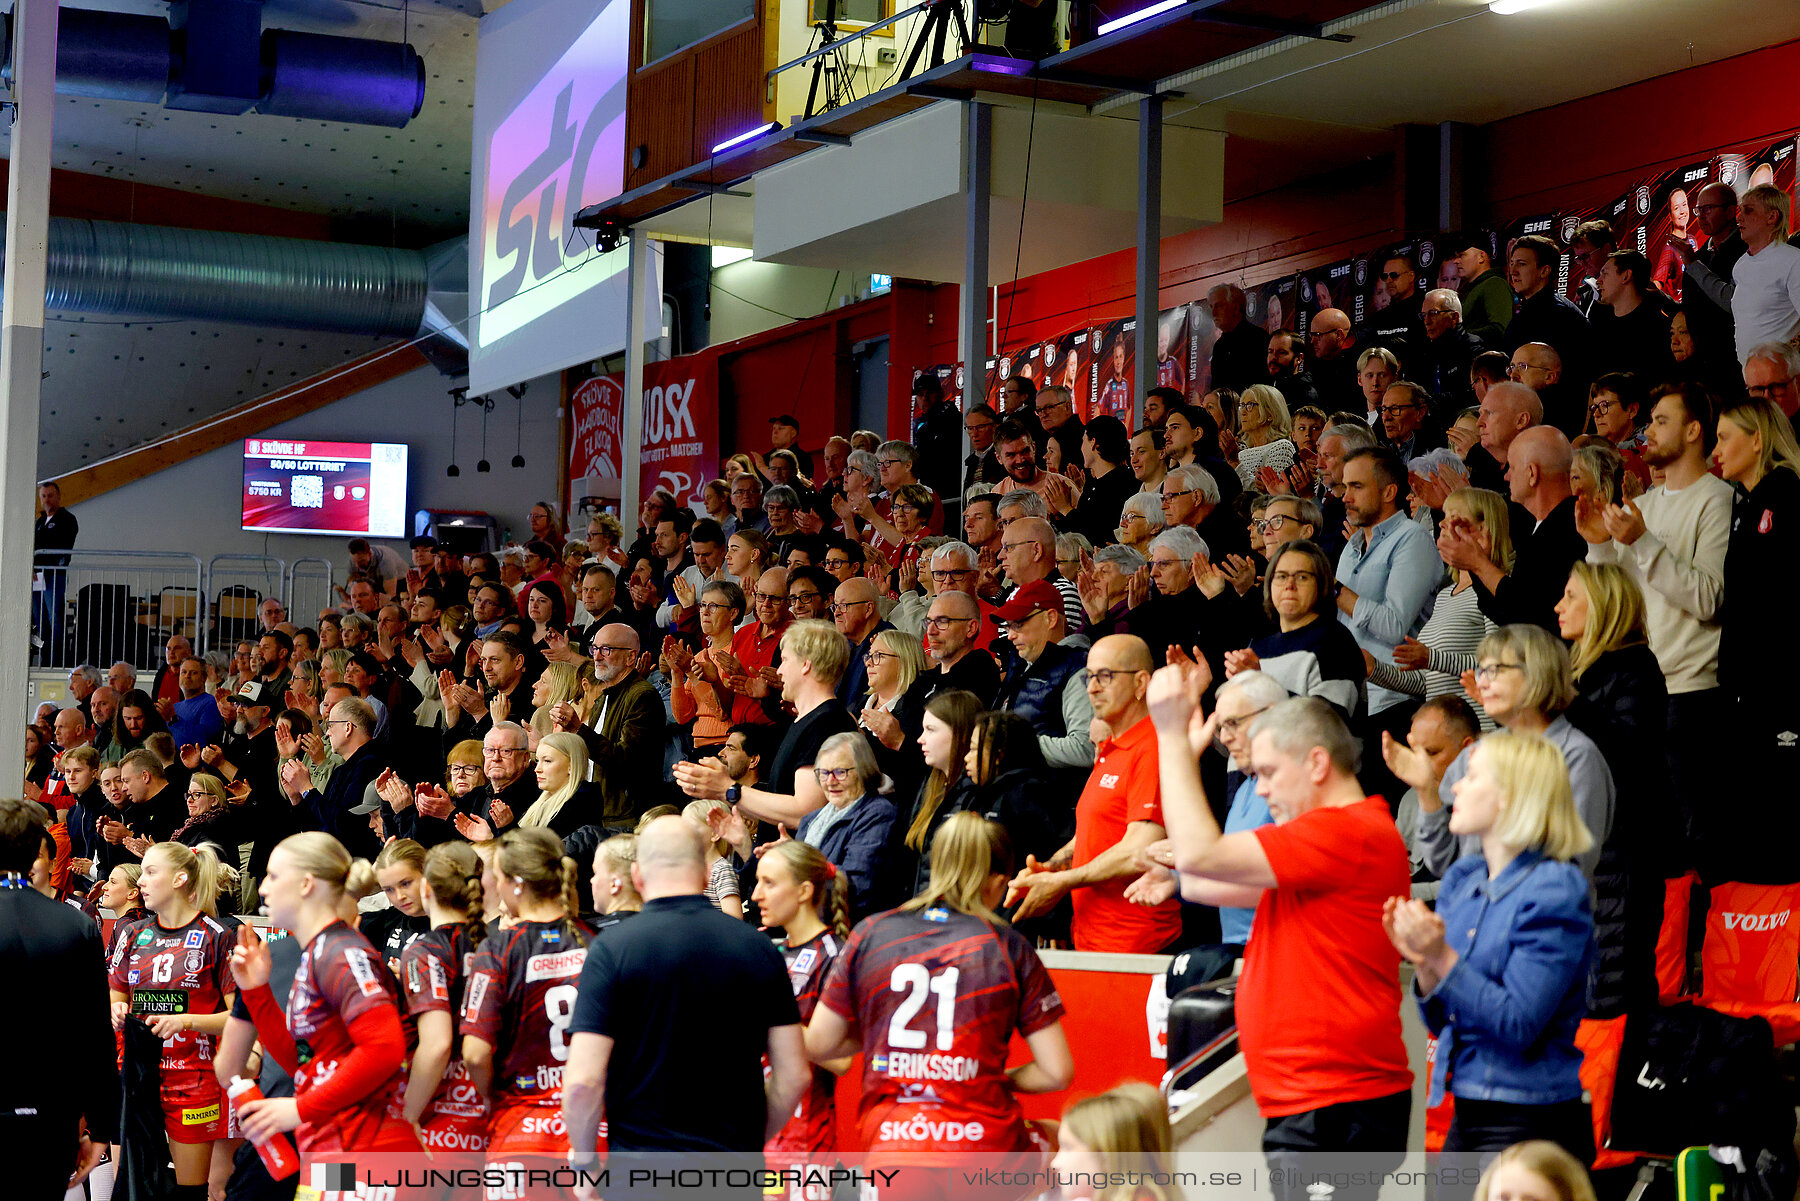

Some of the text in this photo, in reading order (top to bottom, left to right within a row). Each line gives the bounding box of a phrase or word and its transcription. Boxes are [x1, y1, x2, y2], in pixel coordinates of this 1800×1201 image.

[1684, 167, 1709, 183] SHE
[1524, 220, 1552, 233] SHE
[1331, 265, 1351, 278] SHE
[1355, 294, 1364, 325] BERG
[1122, 321, 1137, 332] SHE
[261, 440, 306, 455] SKÖVDE HF
[270, 459, 346, 472] 50/50 LOTTERIET
[270, 487, 282, 496] KR
[1722, 909, 1790, 931] VOLVO
[152, 953, 175, 983] 13
[180, 981, 201, 989] zerva
[132, 990, 184, 1003] GRÖNSAKS
[143, 1002, 176, 1012] HUSET
[888, 963, 960, 1050] 21
[544, 984, 579, 1062] 8
[888, 1051, 979, 1082] ERIKSSON
[185, 1108, 220, 1121] RAMIRENT
[521, 1111, 568, 1136] SKÖ
